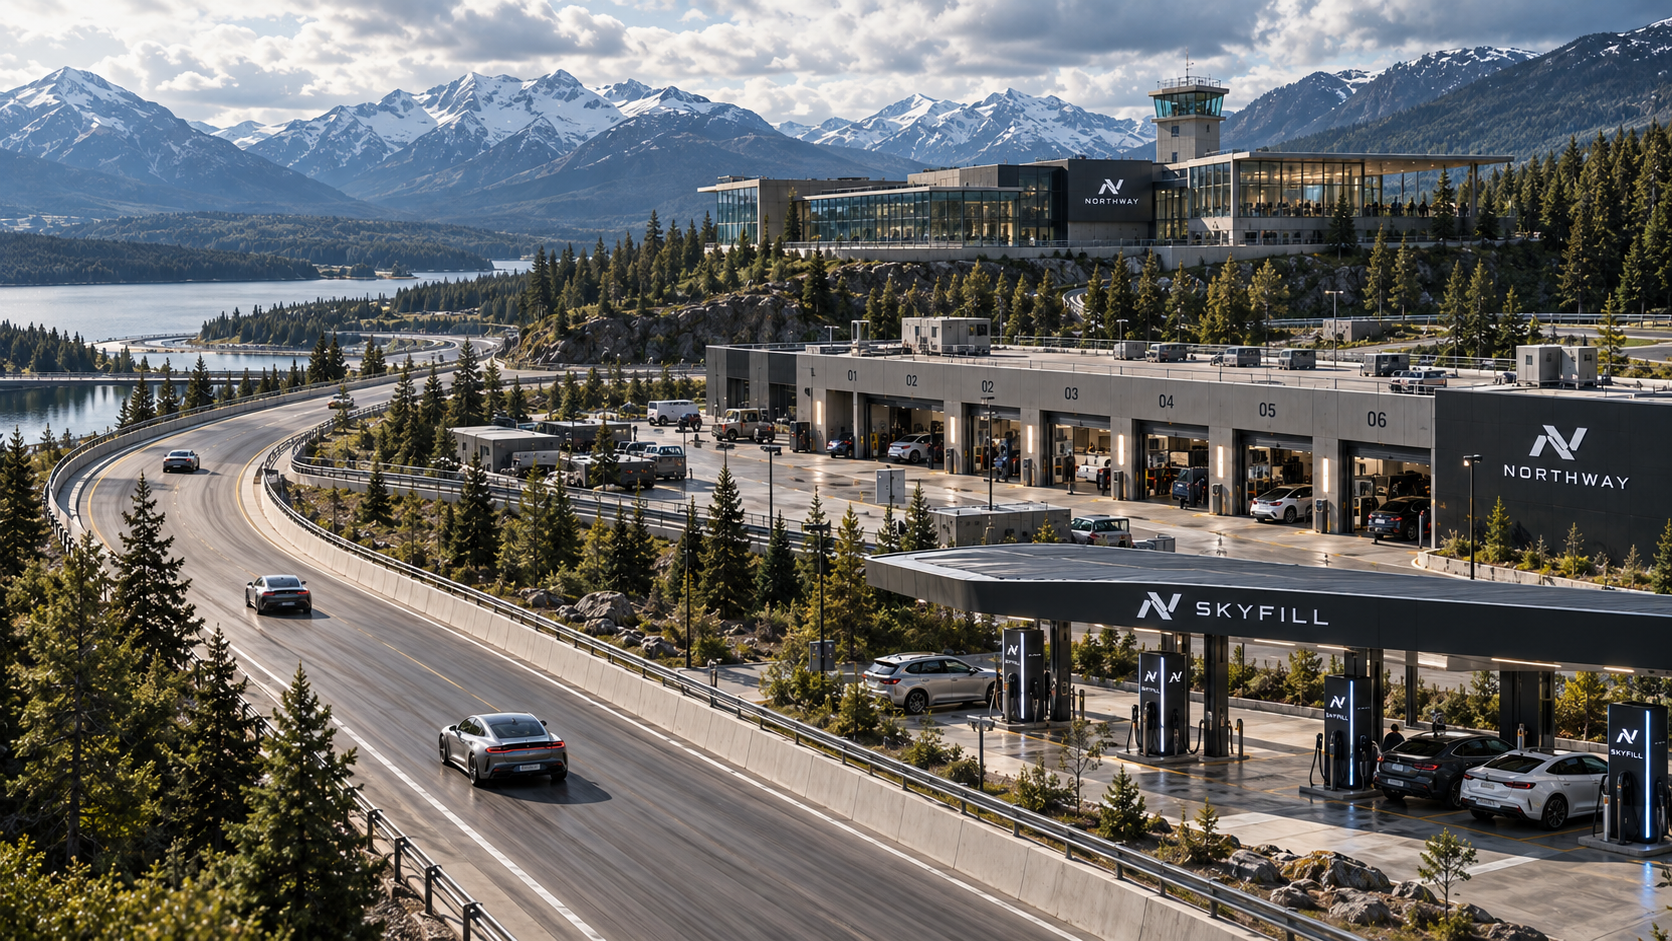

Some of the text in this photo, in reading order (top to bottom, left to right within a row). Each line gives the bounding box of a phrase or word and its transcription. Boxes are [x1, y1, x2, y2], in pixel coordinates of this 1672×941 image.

[847, 369, 857, 382] 01
[906, 374, 918, 387] 02
[981, 380, 994, 393] 02
[1064, 386, 1079, 401] 03
[1158, 394, 1174, 409] 04
[1259, 402, 1276, 418] 05
[1367, 410, 1387, 428] 06
[1503, 464, 1629, 490] NORTHWAY
[1196, 601, 1329, 626] SKYFILL
[1610, 748, 1643, 760] SKYFILL
